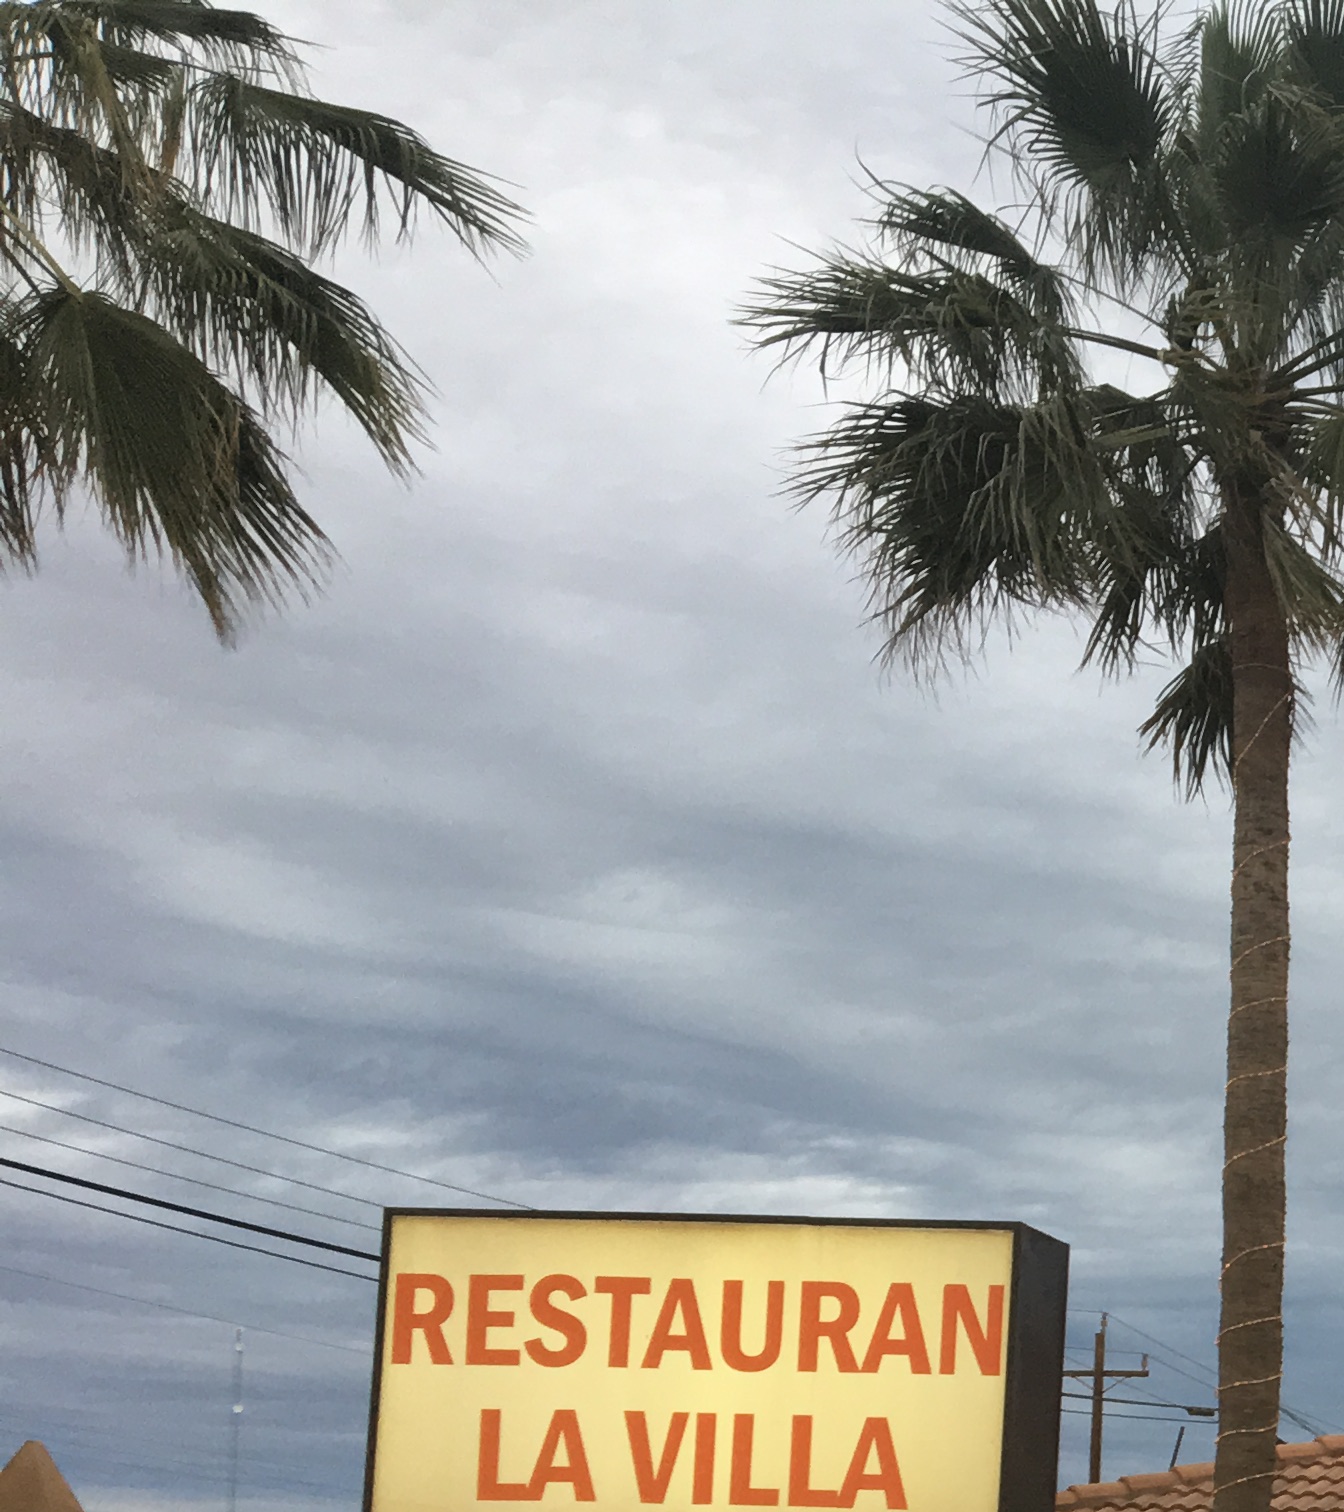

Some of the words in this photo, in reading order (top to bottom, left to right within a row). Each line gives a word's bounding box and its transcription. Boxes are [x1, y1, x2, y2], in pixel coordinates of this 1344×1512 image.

[390, 1272, 1005, 1377] RESTAURAN
[475, 1408, 597, 1502] LA
[622, 1410, 909, 1511] VILLA
